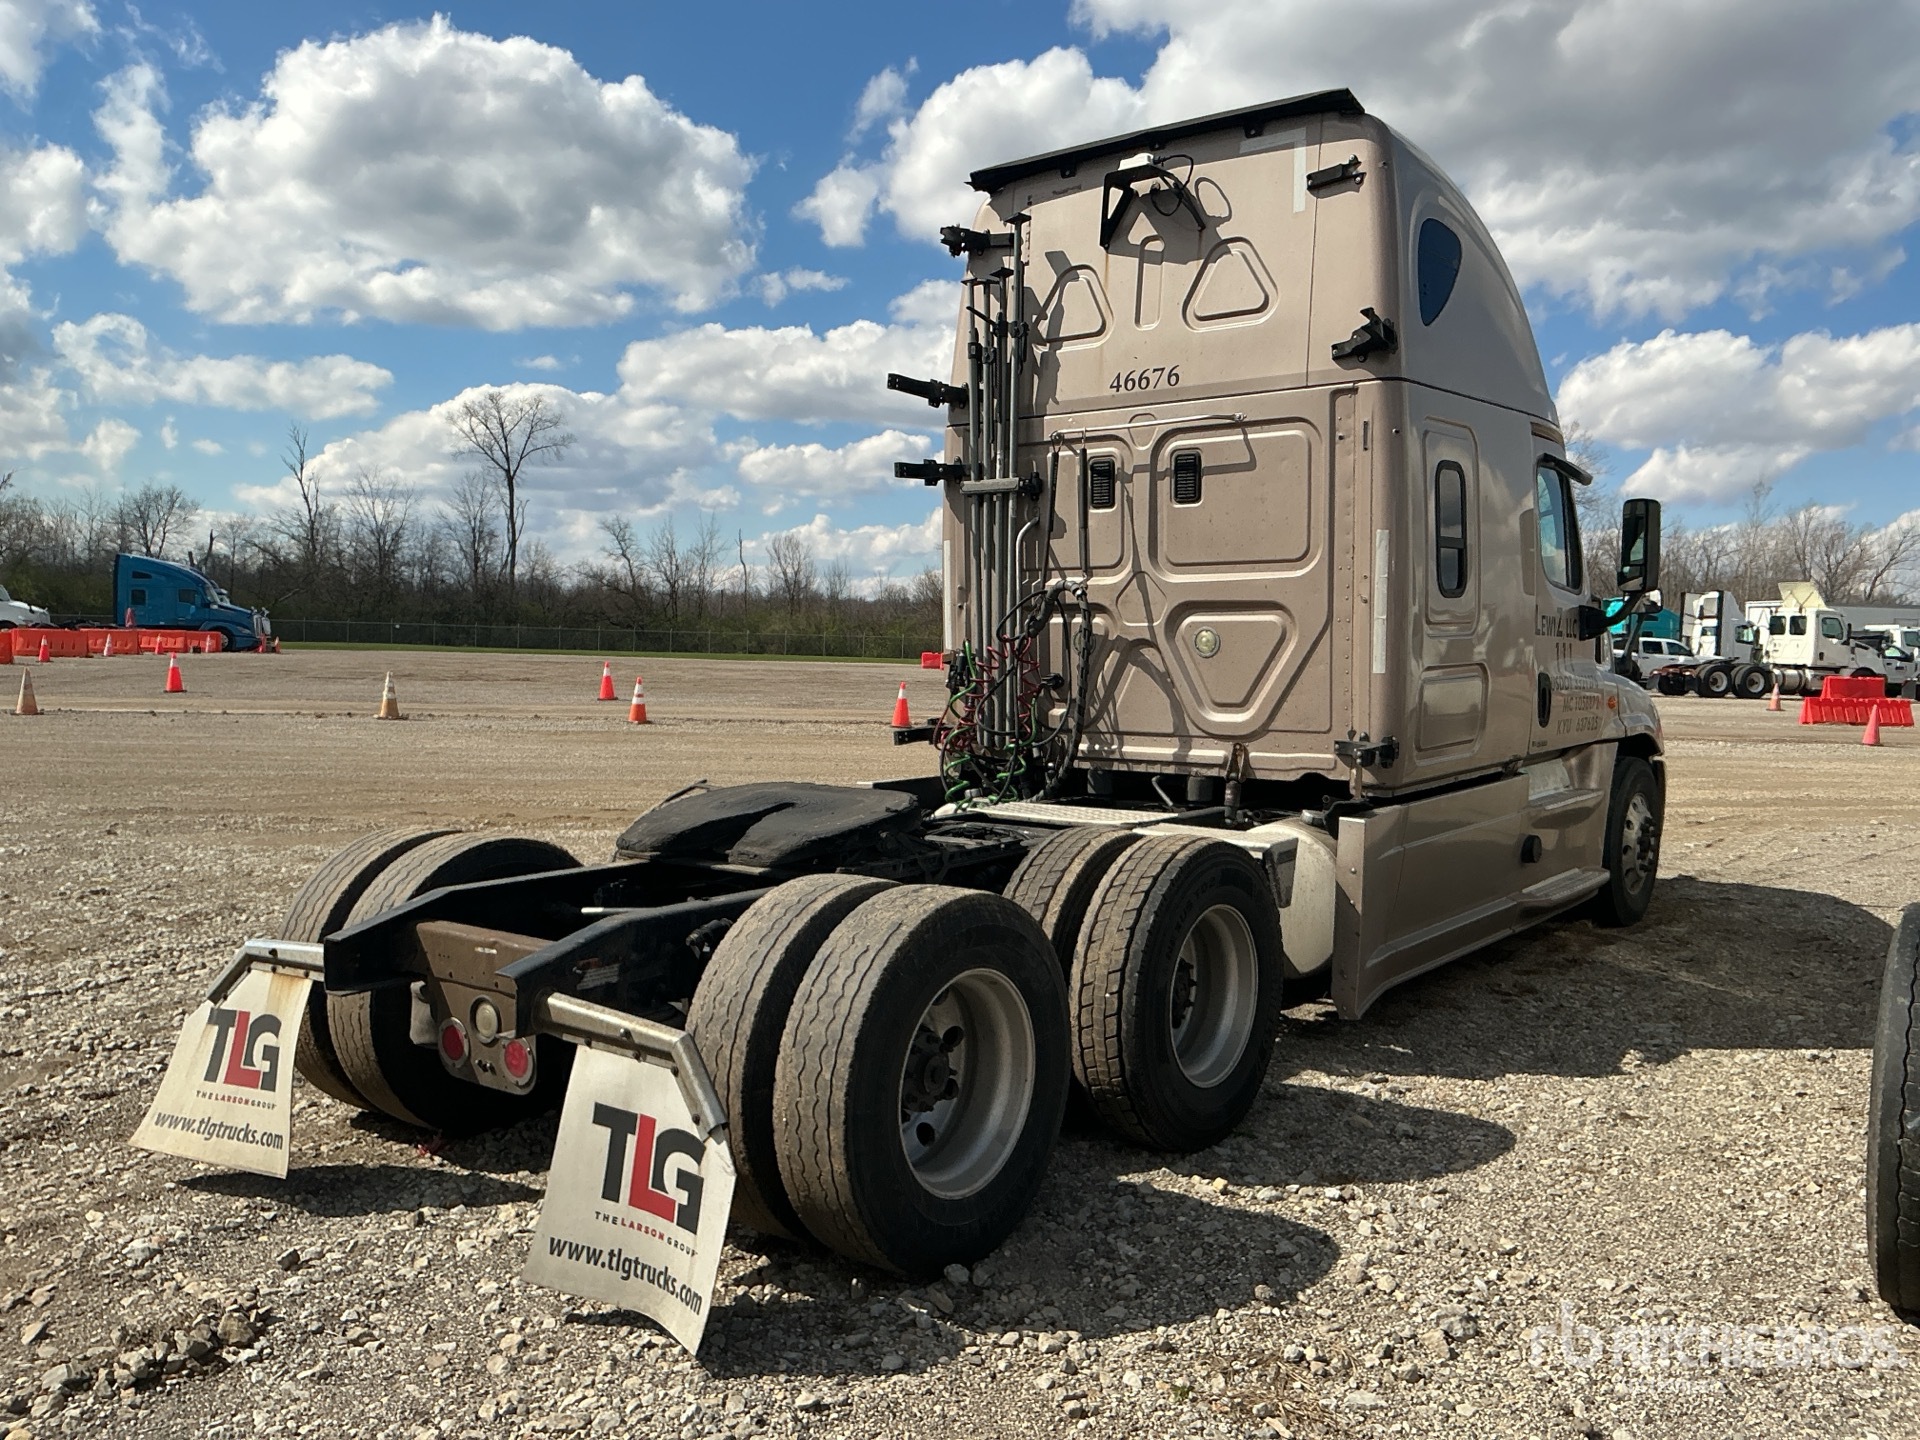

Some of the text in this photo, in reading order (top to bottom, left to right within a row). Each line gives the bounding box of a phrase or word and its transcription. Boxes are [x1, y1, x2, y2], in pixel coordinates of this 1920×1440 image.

[1109, 364, 1180, 393] 46676
[203, 1007, 282, 1092] TLG
[196, 1090, 214, 1100] THE
[214, 1093, 251, 1106] LARSON
[154, 1112, 284, 1151] www.tlgtrucks.com
[592, 1101, 707, 1235] TLG
[594, 1211, 697, 1258] THE LARSON GROUP
[549, 1236, 703, 1316] www.tlgtrucks.com
